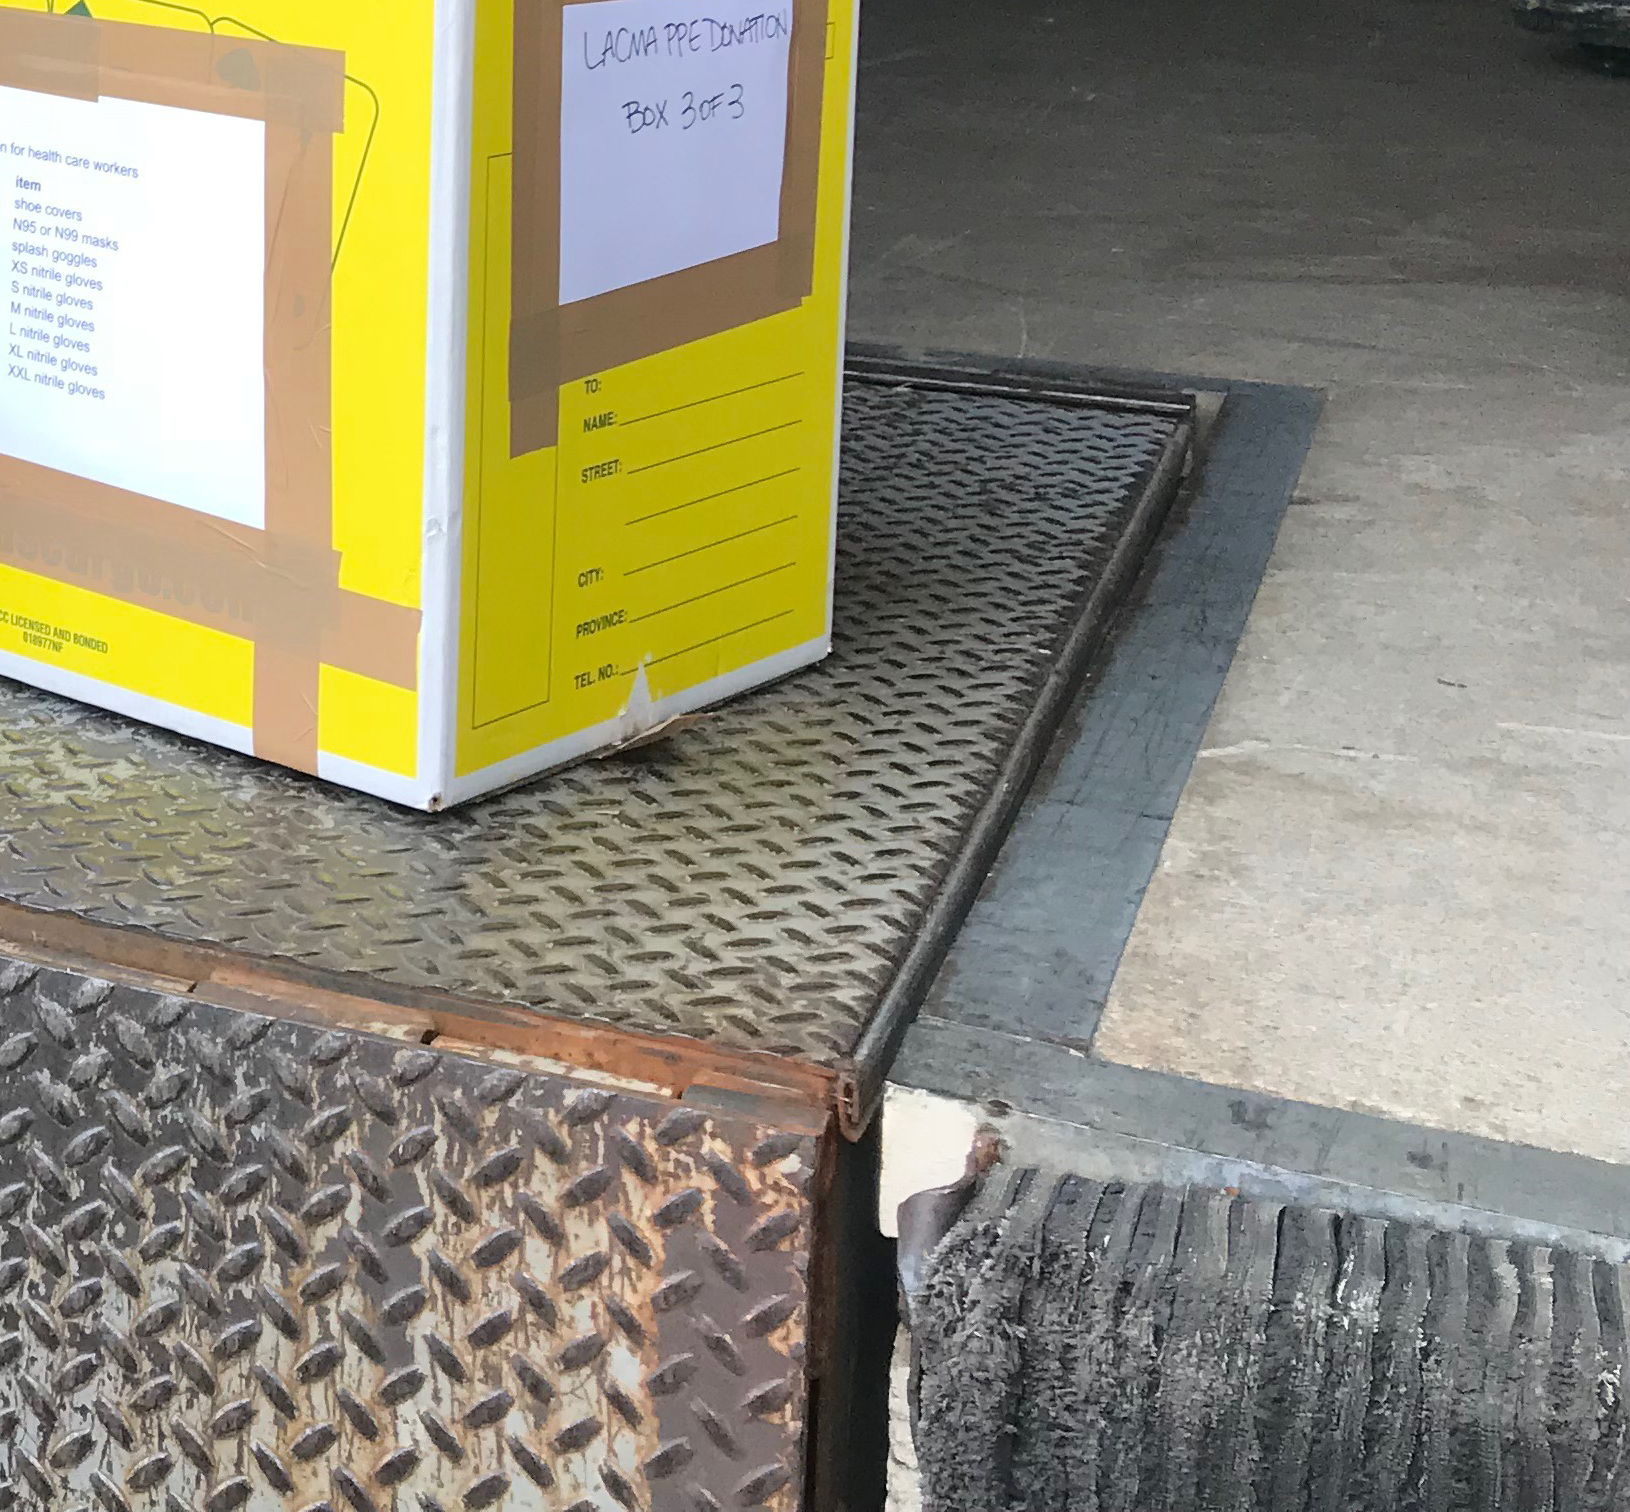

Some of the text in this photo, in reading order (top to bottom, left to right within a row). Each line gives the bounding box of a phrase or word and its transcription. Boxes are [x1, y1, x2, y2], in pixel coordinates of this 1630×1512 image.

[584, 8, 790, 70] LACMA PPE DONATION
[621, 83, 745, 134] BOX 3 OF 3
[10, 142, 26, 157] for
[28, 145, 62, 164] health
[65, 153, 90, 169] care
[93, 160, 140, 179] workers
[15, 175, 42, 192] item
[14, 197, 83, 222] shoe covers
[13, 217, 119, 252] N95 or N99 masks
[12, 240, 98, 269] splash goggles
[11, 259, 104, 292] XS nitrile gloves
[11, 280, 94, 311] S nitrile gloves
[10, 301, 95, 332] M nitrile gloves
[9, 322, 90, 353] L nitrile gloves
[8, 343, 98, 376] XL nitrile gloves
[8, 363, 106, 400] XXL nitrile gloves
[584, 378, 602, 394] TO:
[583, 411, 618, 433] NAME:
[580, 458, 623, 484] STREET:
[577, 567, 605, 588] CITY:
[10, 613, 51, 636] LICENSED
[52, 627, 71, 643] AND
[73, 632, 109, 654] BONDED
[576, 609, 628, 640] PROVINCE:
[574, 673, 596, 690] TEL.
